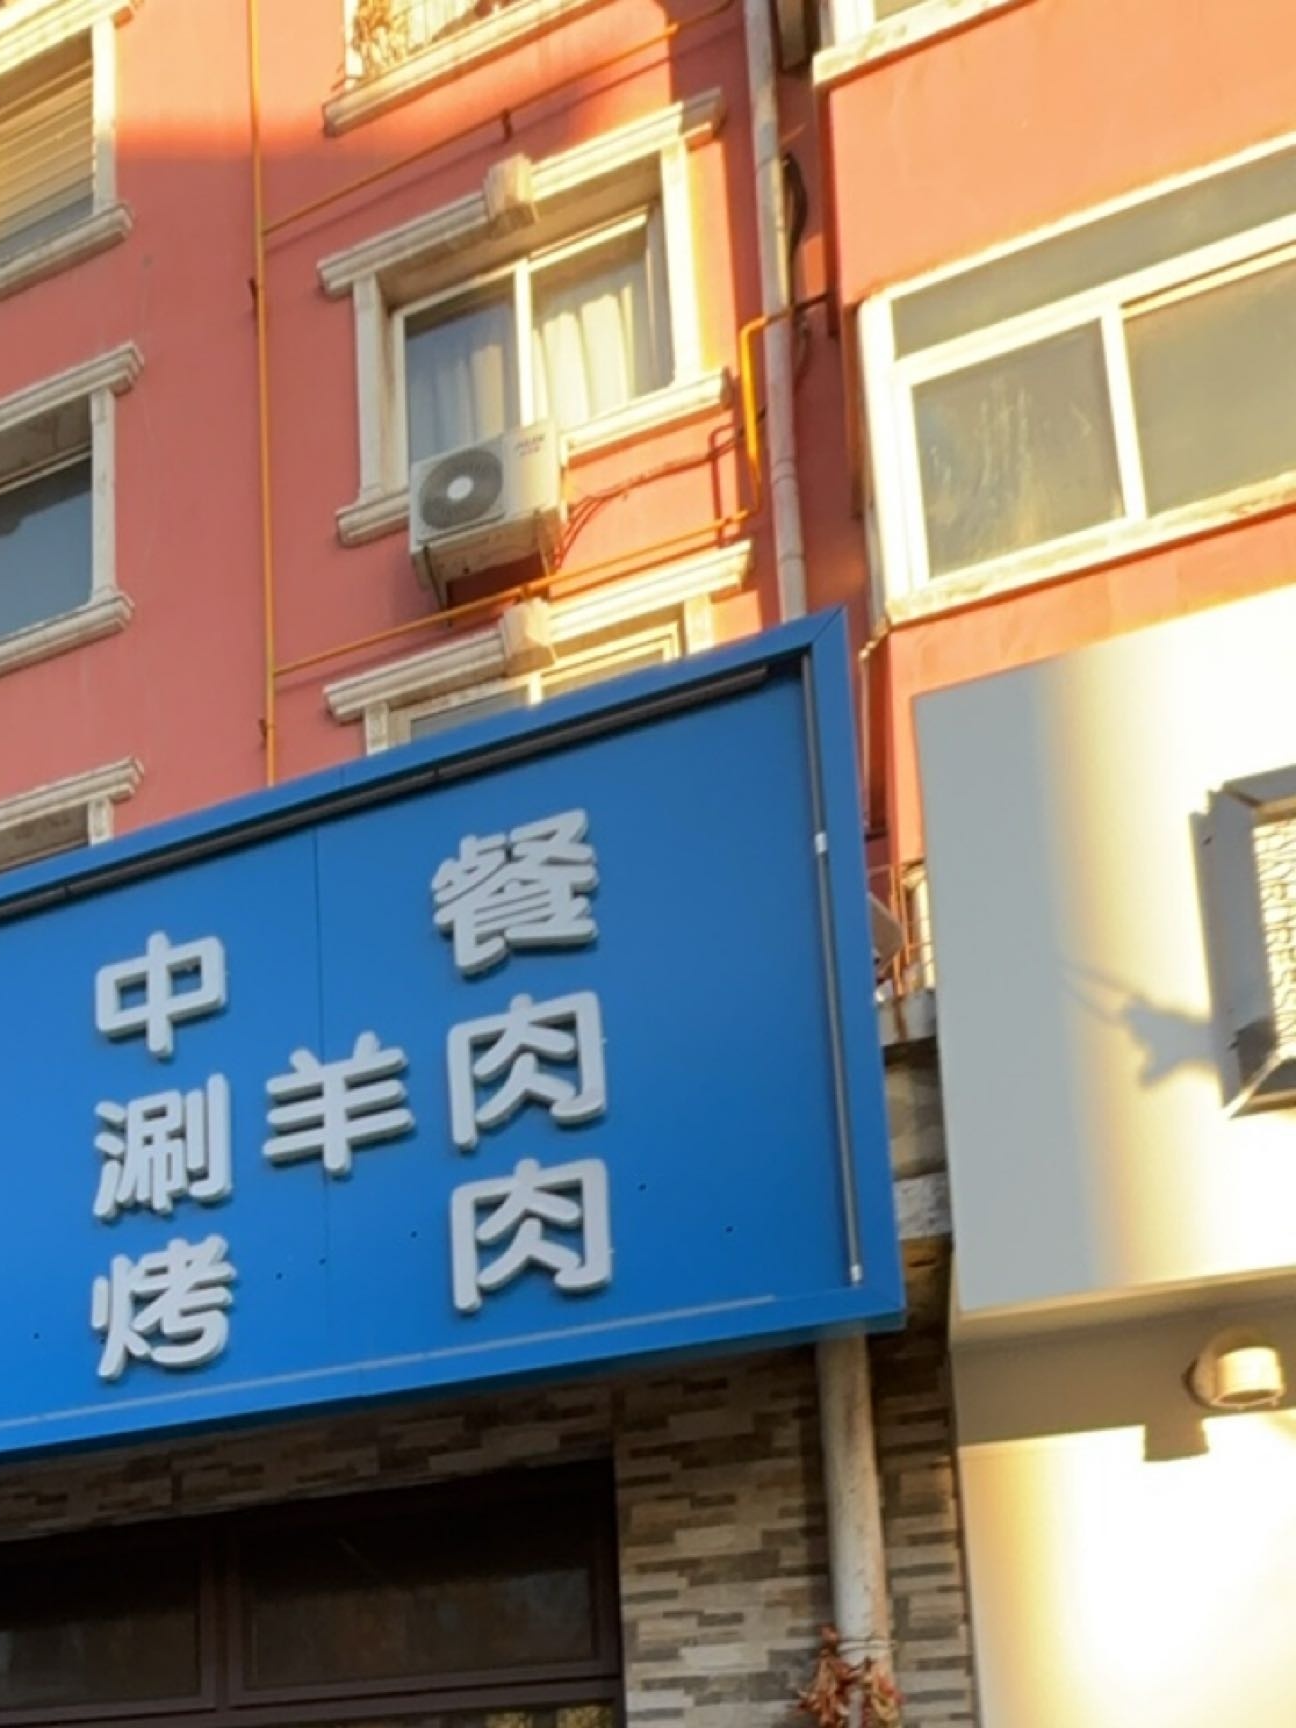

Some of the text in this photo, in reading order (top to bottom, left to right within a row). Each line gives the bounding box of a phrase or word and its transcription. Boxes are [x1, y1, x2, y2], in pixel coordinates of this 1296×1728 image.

[95, 808, 599, 1059] 中餐
[93, 992, 607, 1220] 涮羊肉
[91, 1158, 612, 1382] 烤肉
